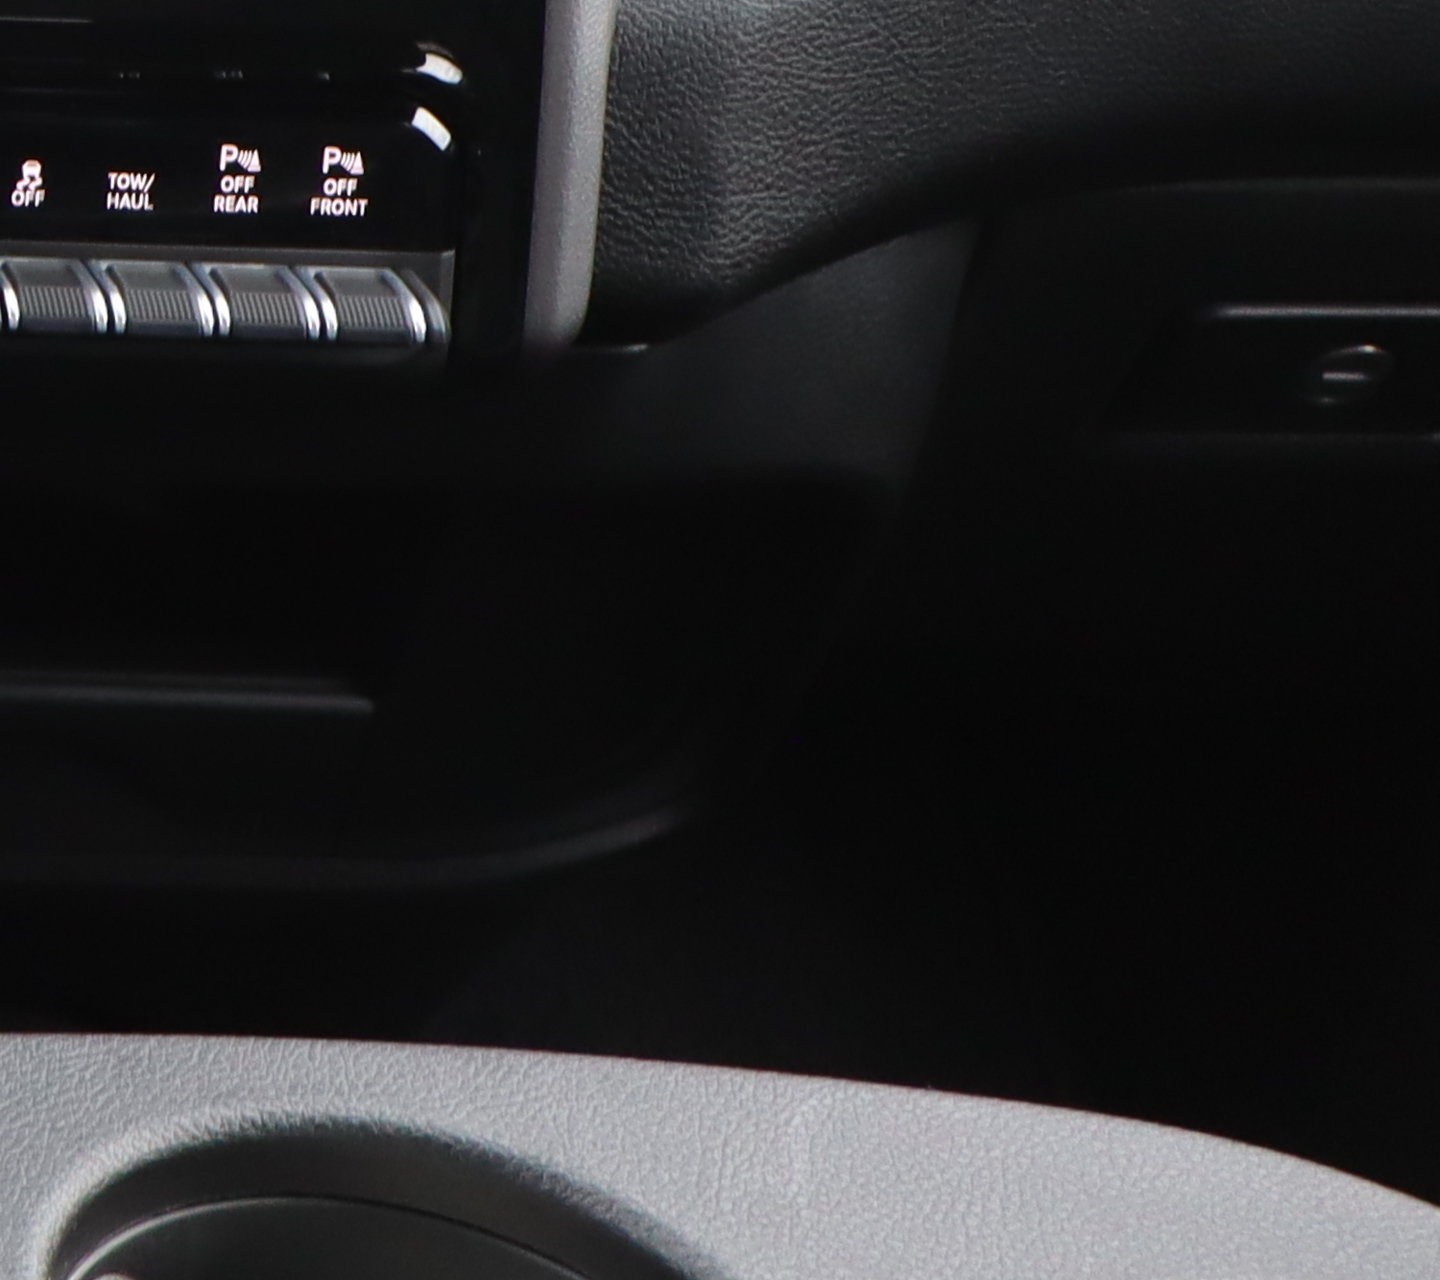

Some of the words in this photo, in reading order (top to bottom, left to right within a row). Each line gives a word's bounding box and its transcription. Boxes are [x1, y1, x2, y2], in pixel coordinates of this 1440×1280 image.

[107, 172, 155, 191] TOW/
[220, 175, 255, 193] OFF
[323, 178, 358, 196] OFF
[11, 189, 46, 207] OFF
[107, 192, 154, 211] HAUL
[213, 195, 259, 214] REAR
[310, 197, 369, 216] FRONT
